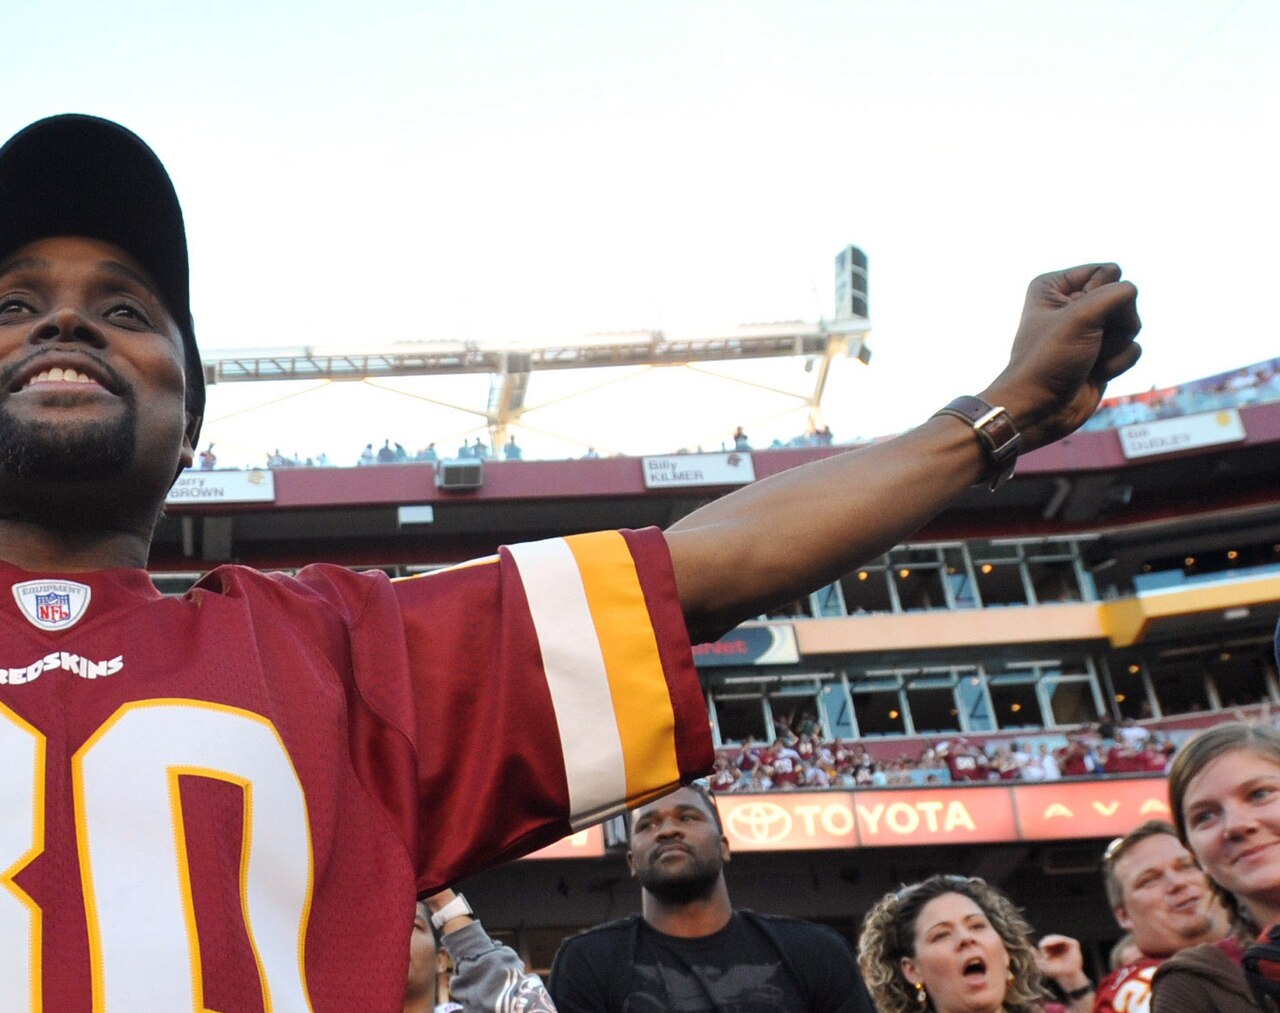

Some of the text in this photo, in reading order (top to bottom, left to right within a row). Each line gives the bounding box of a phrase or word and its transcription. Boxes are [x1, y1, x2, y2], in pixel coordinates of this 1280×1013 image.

[650, 471, 704, 482] KILMER
[22, 584, 83, 596] EQUIPMENT
[39, 604, 69, 622] NFL
[794, 799, 977, 838] TOYOTA
